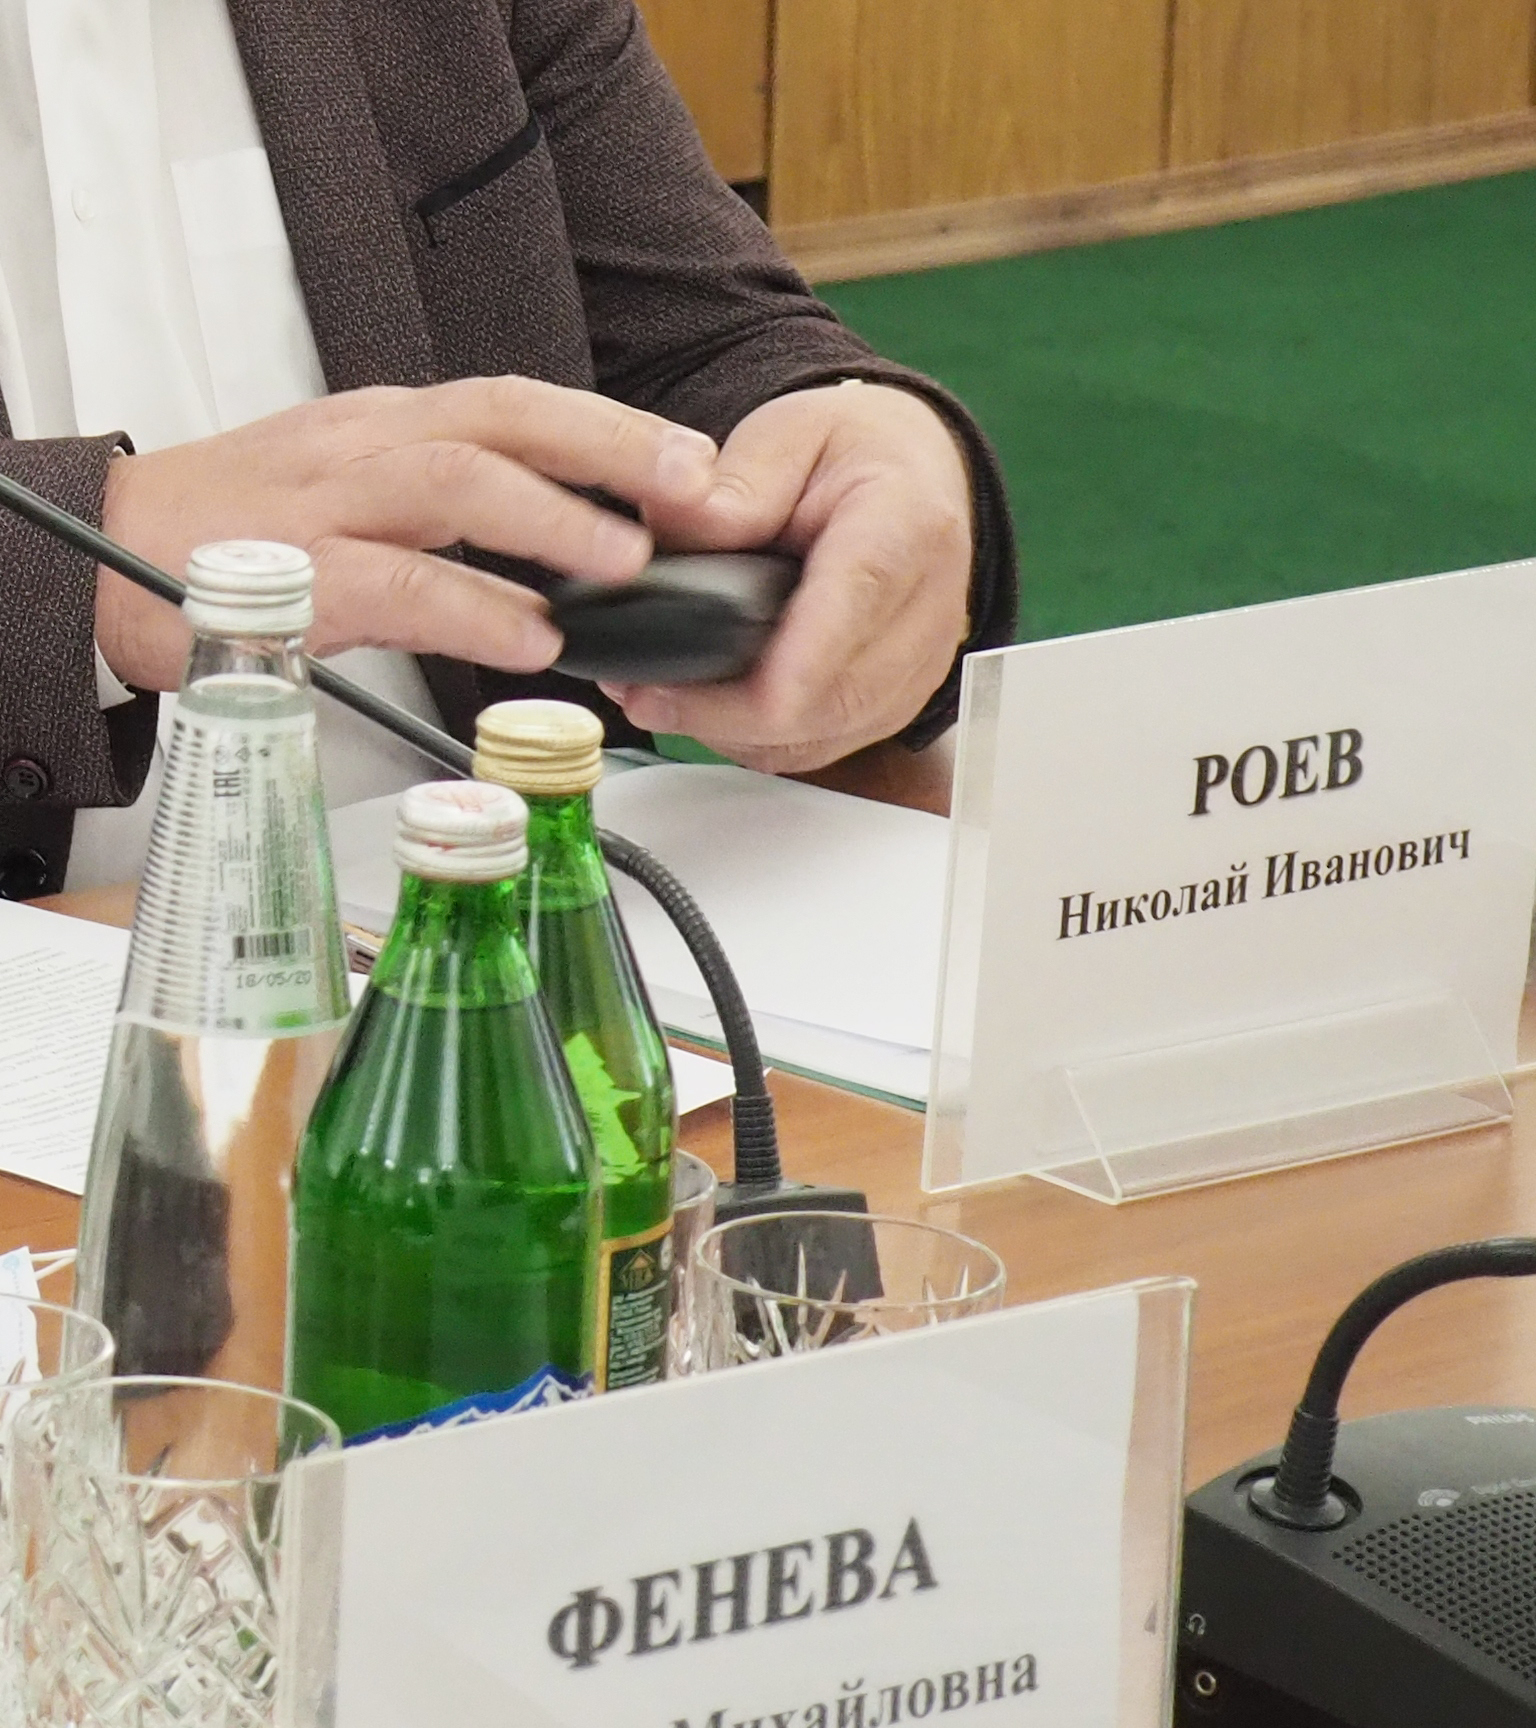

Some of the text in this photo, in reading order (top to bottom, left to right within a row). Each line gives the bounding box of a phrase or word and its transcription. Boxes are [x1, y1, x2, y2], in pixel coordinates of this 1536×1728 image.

[1188, 727, 1365, 817] РОЕВ
[1055, 829, 1472, 941] Николай Иванович
[546, 1516, 940, 1670] ФЕНЕВА
[669, 1652, 1040, 1728] хайловна
